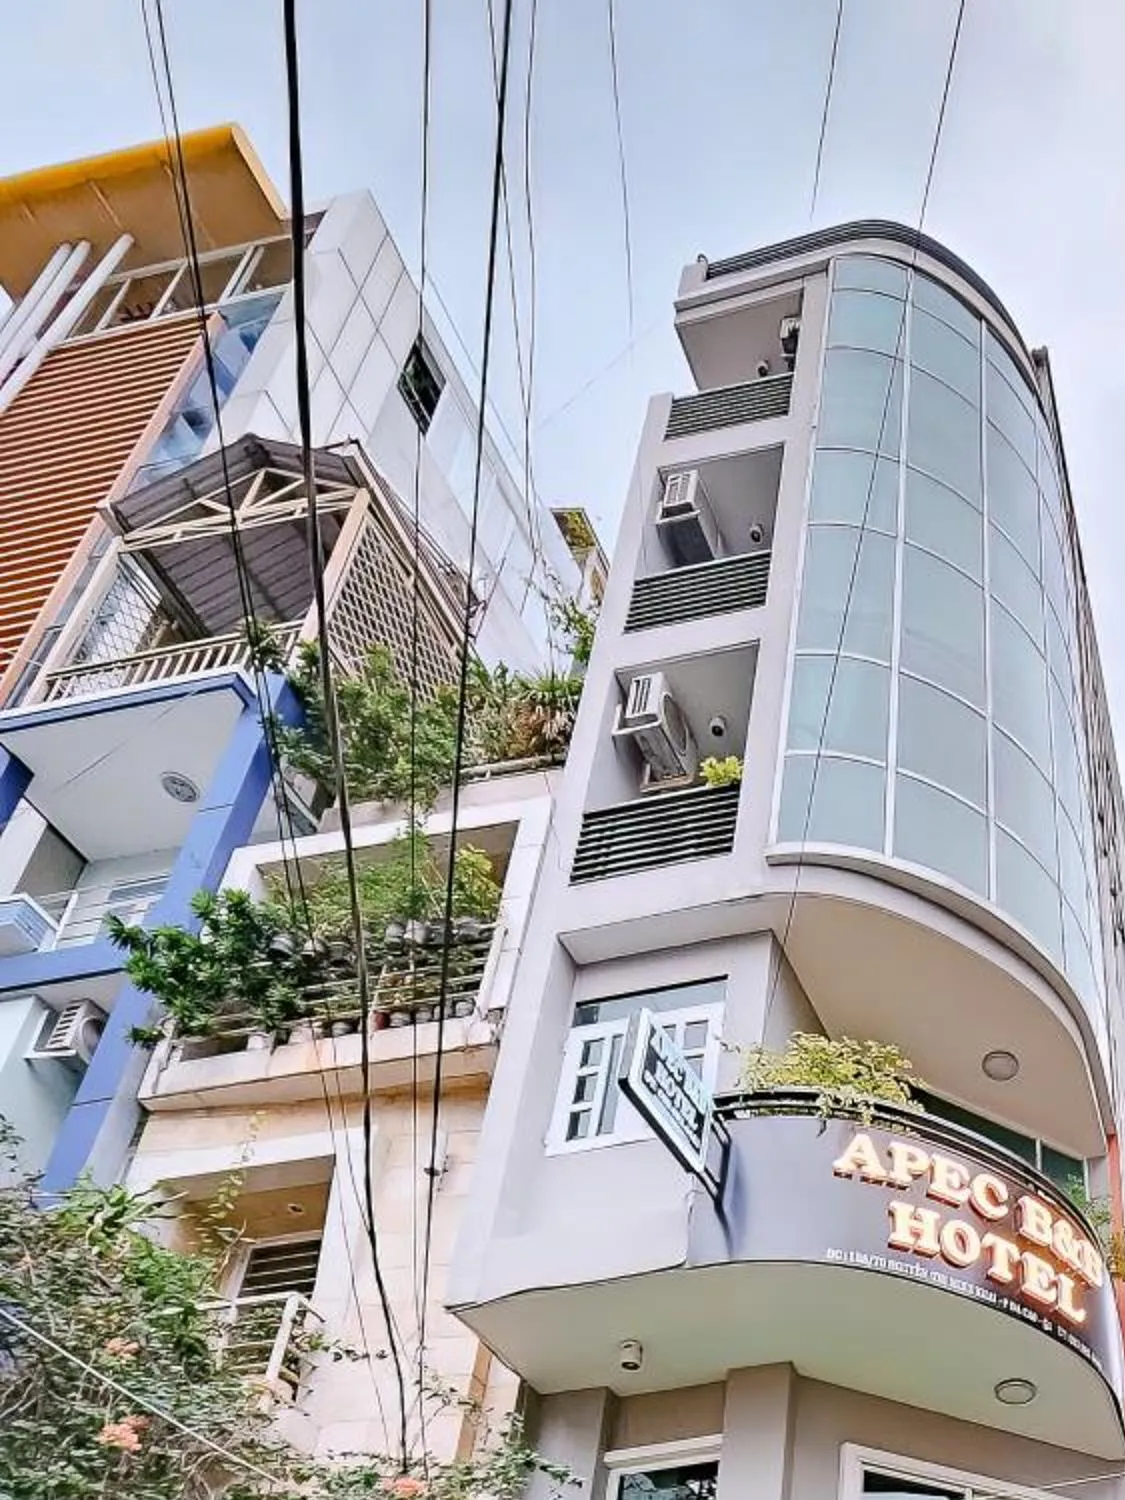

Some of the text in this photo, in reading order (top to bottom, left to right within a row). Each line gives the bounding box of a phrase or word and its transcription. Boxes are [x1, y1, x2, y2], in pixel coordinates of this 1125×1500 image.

[832, 1133, 1102, 1288] APEC B&B
[887, 1201, 1087, 1326] HOTEL
